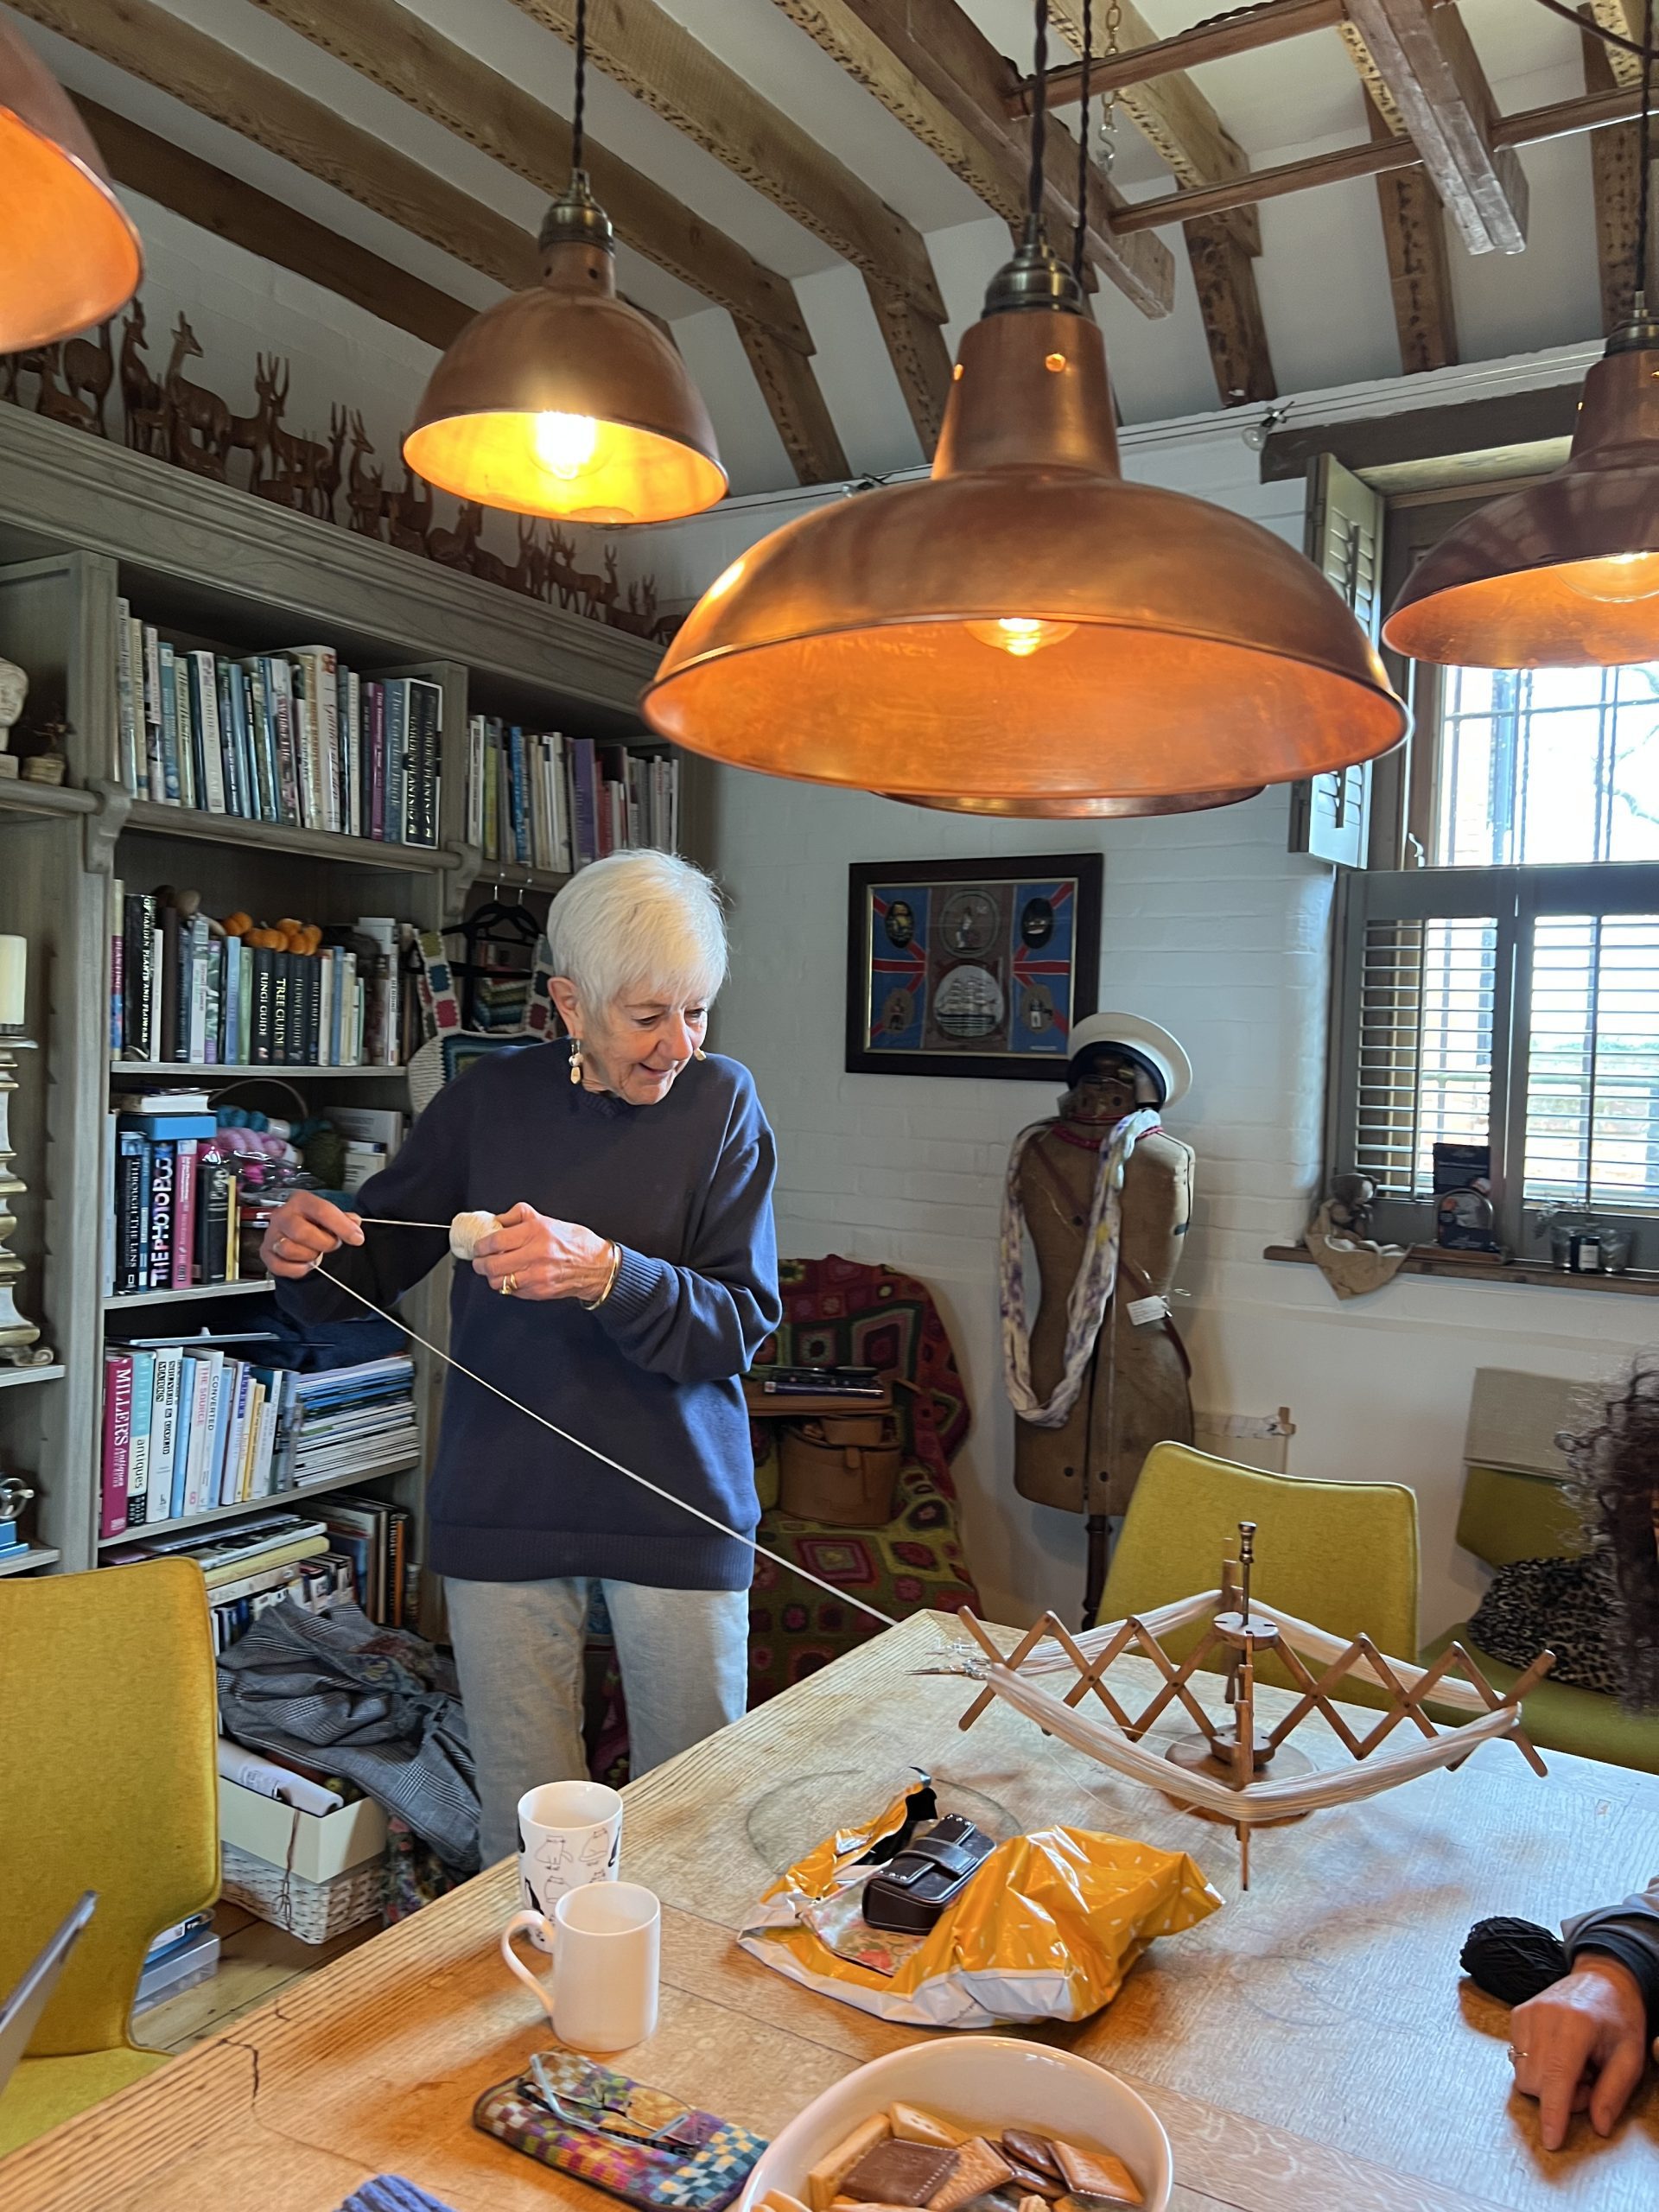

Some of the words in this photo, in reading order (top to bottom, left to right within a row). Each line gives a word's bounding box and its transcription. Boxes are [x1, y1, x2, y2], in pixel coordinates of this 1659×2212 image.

[259, 972, 269, 1002] FUNGI
[276, 978, 286, 1007] TREE
[258, 1005, 269, 1036] GUIDE
[275, 1008, 285, 1046] GUIDE
[130, 1160, 140, 1214] THROUGH
[130, 1217, 139, 1238] THE
[130, 1242, 139, 1268] LENS
[156, 1361, 166, 1402] MARKS
[165, 1361, 175, 1406] SILVER
[199, 1367, 208, 1386] THE
[113, 1368, 131, 1446] MILLER'S
[197, 1388, 207, 1426] SOURCE
[208, 1376, 219, 1431] CONVERTED
[162, 1421, 171, 1455] GOLD
[132, 1439, 147, 1490] antiques
